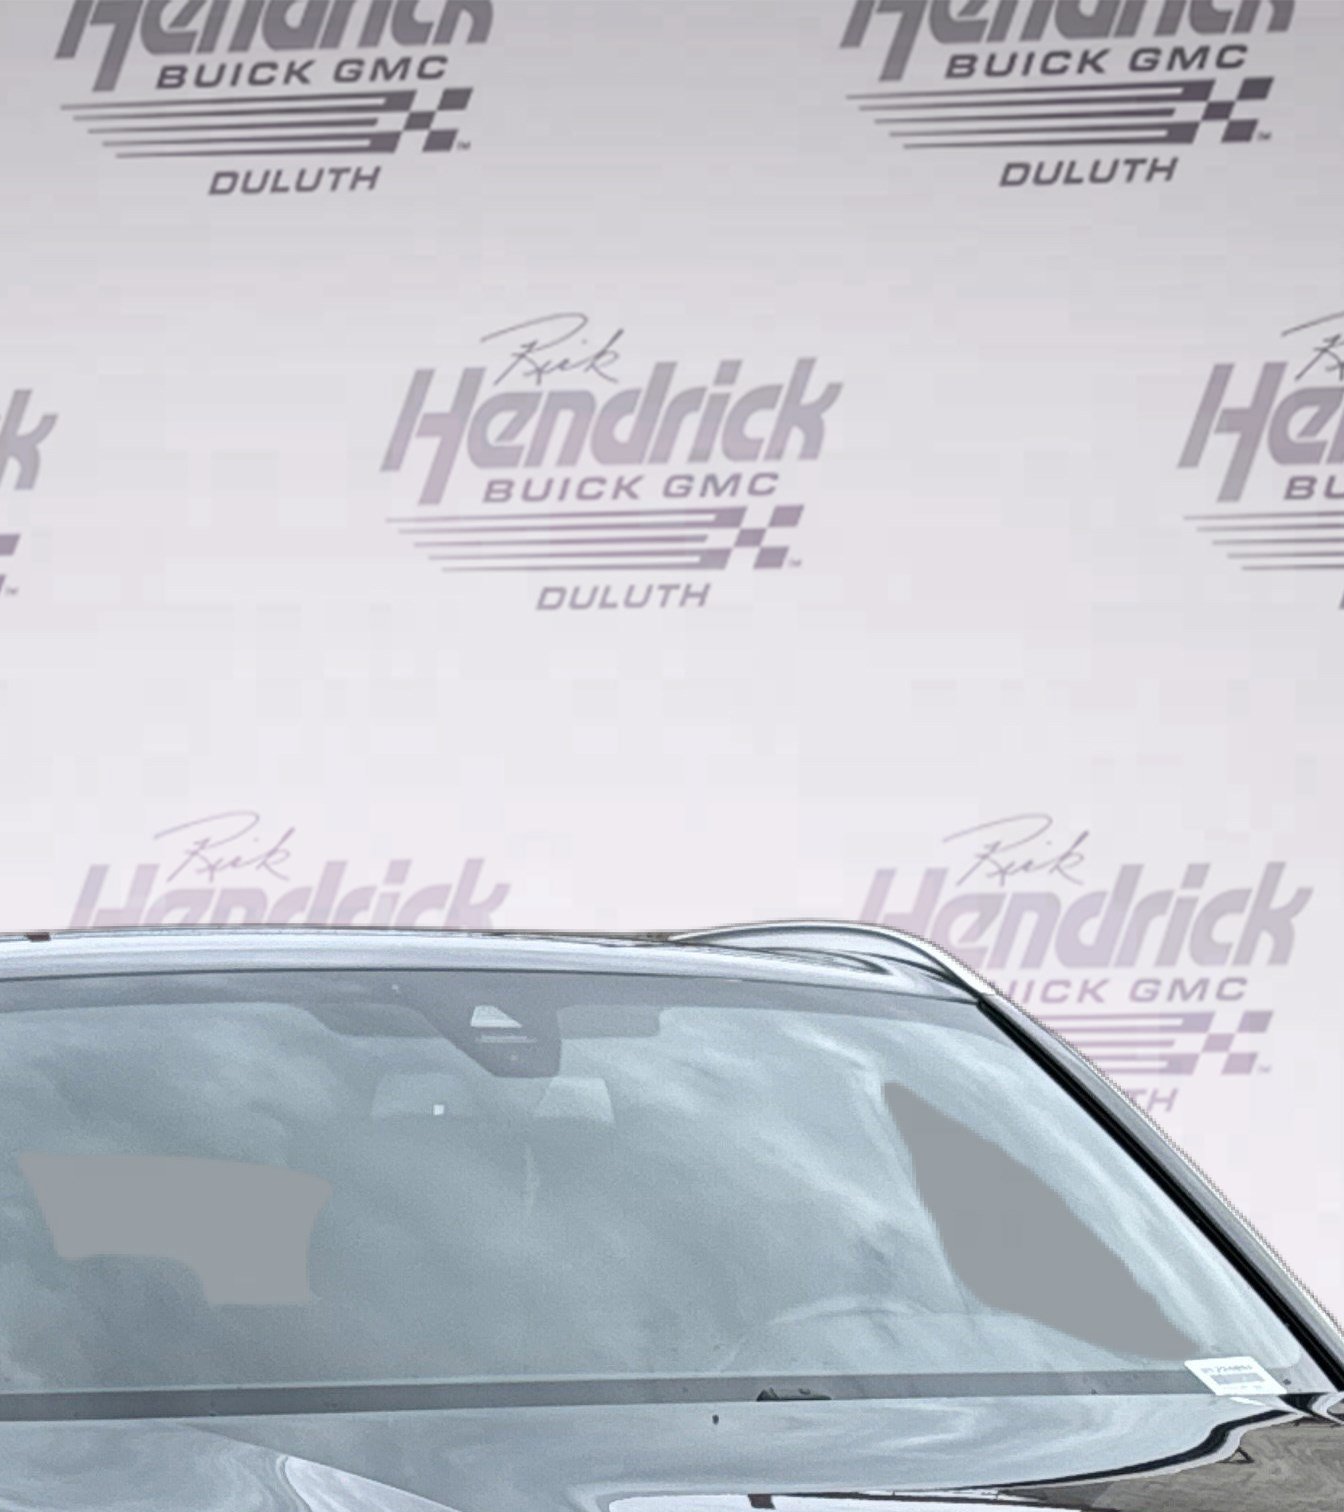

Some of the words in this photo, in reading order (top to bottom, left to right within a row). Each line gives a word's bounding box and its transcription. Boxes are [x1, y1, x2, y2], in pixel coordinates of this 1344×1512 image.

[156, 60, 315, 89] BUICK
[333, 55, 448, 83] GMC
[945, 48, 1110, 79] BUICK
[1129, 44, 1248, 72] GMC
[208, 166, 381, 195] DULUTH
[999, 157, 1179, 187] DULUTH
[380, 358, 844, 504] Hendrick
[483, 475, 643, 503] BUICK
[663, 472, 779, 498] GMC
[536, 583, 711, 610] DULUTH
[1129, 976, 1248, 1002] GMC
